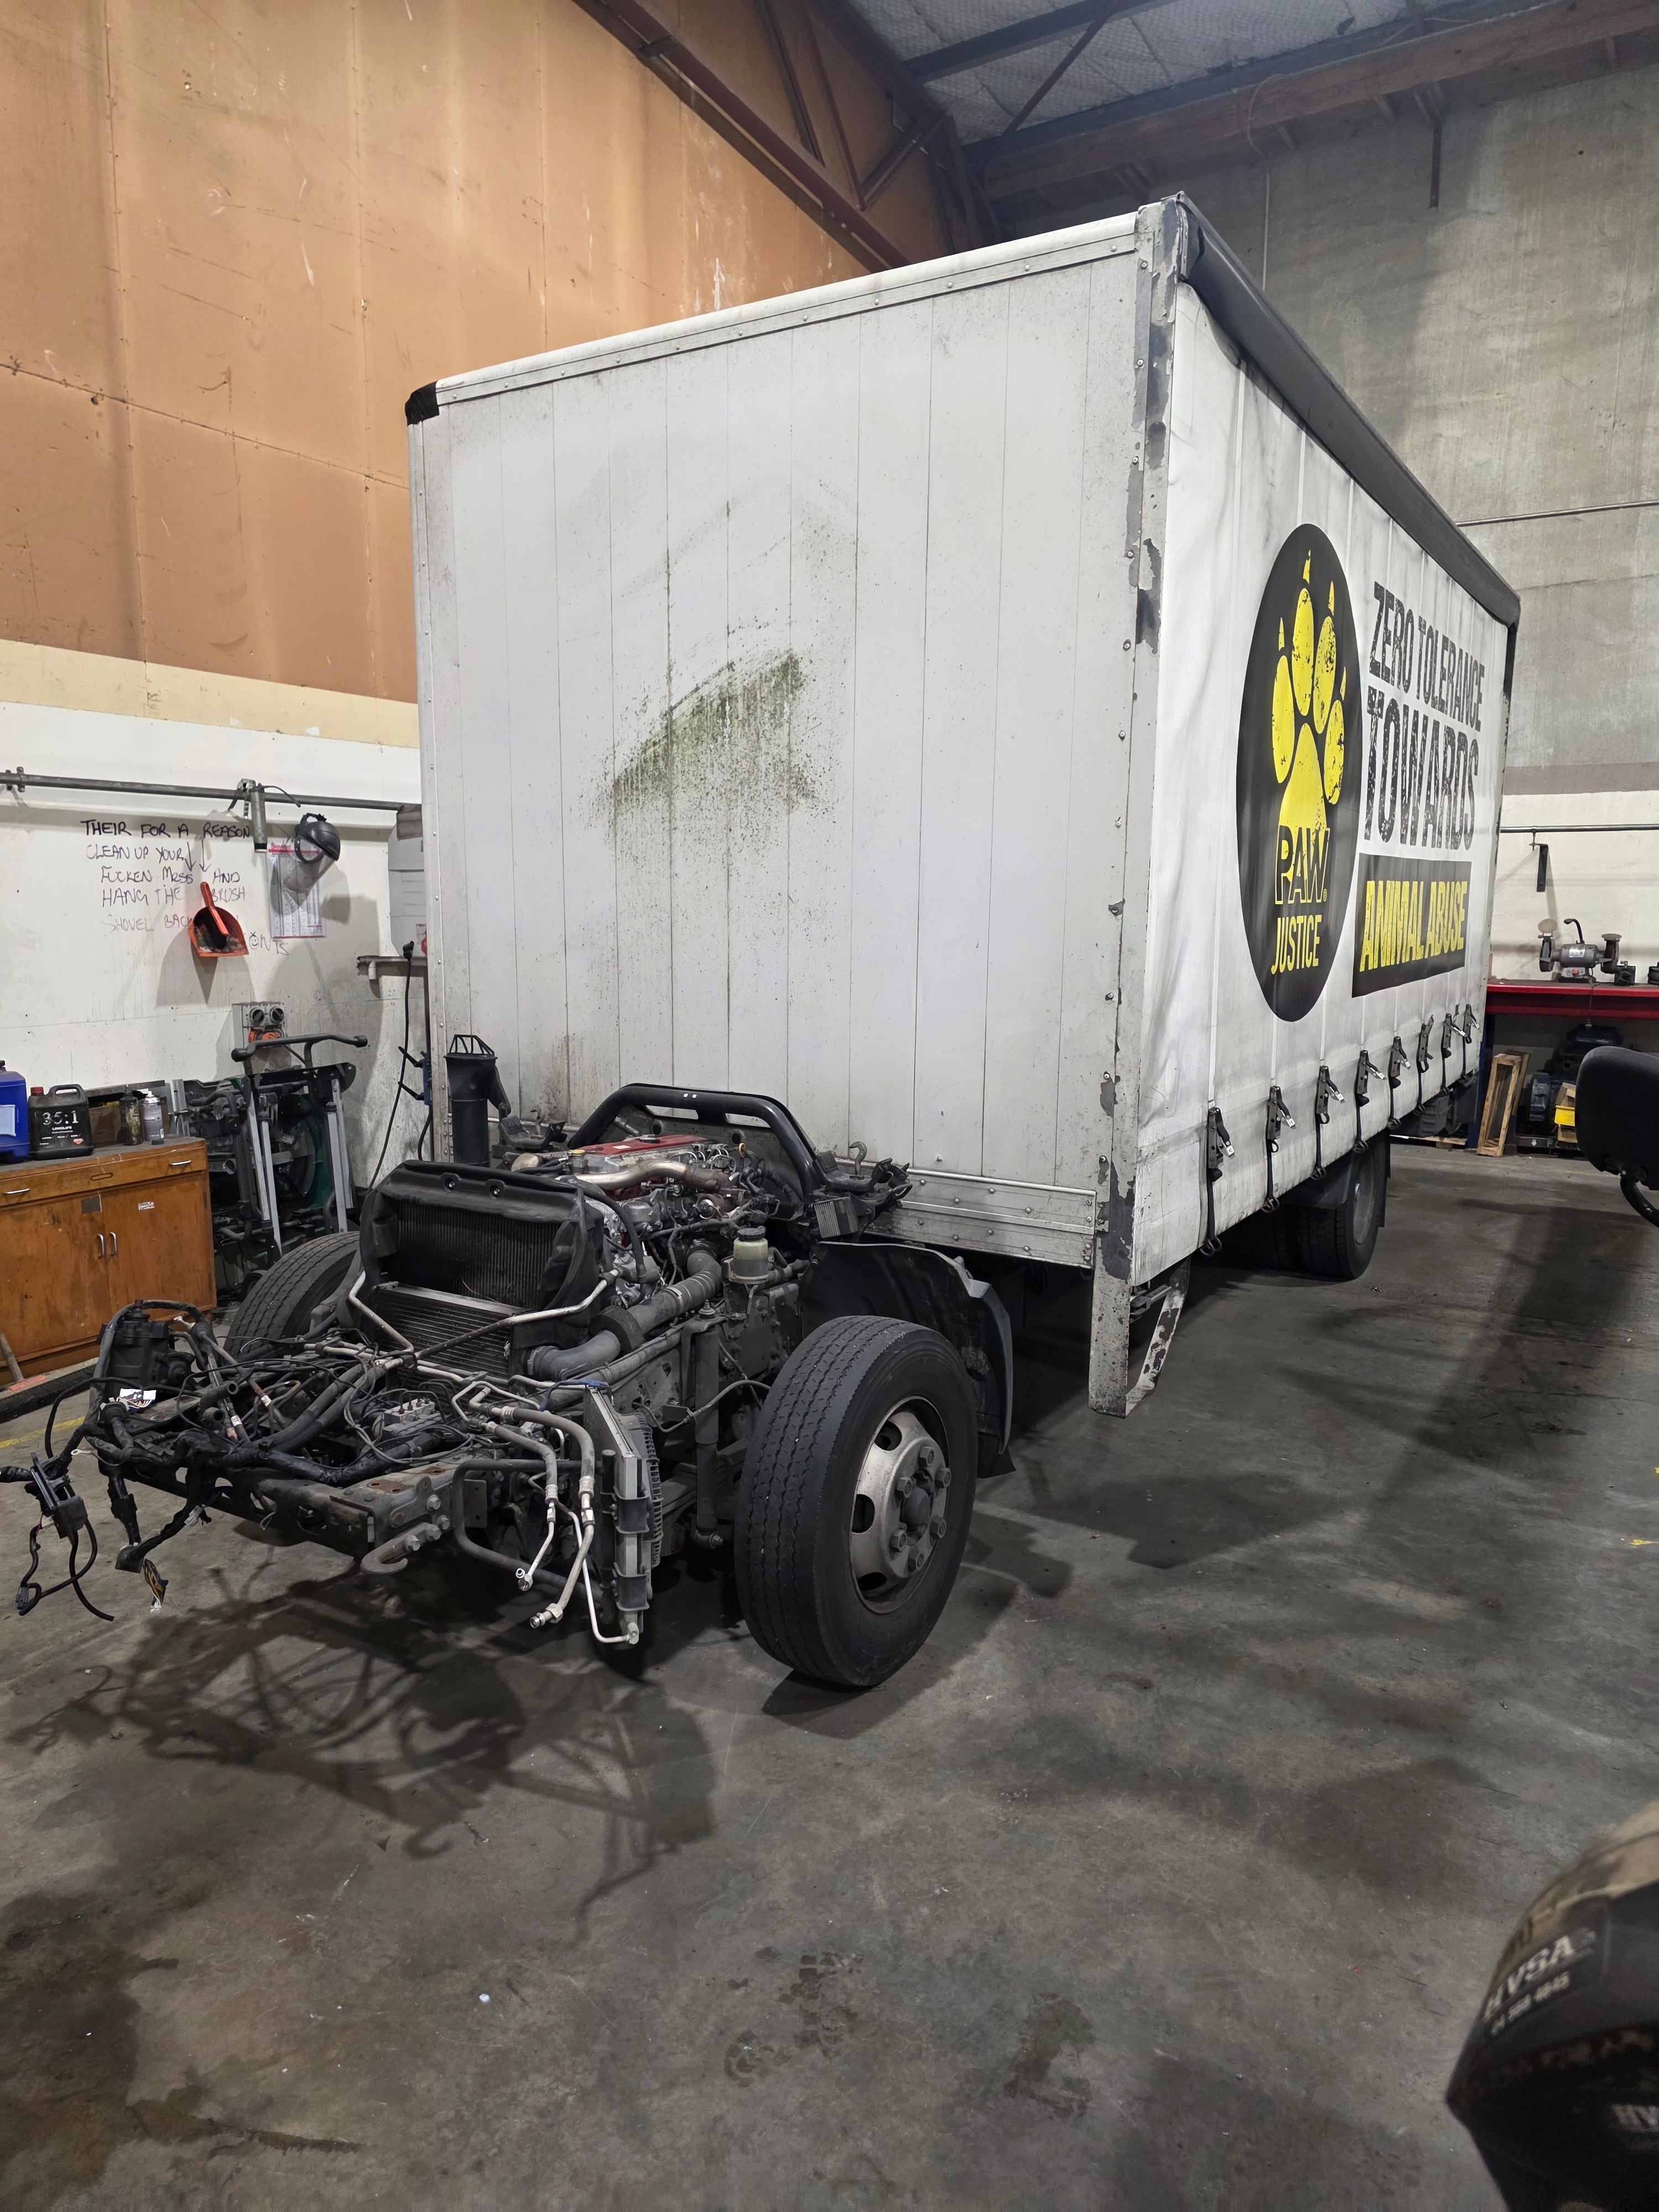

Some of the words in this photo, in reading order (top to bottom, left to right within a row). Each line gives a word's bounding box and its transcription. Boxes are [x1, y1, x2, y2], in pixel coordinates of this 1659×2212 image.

[1369, 581, 1414, 693] ZERO
[1416, 615, 1485, 732] TOLERANCE
[1364, 685, 1479, 851] TOWARDS
[81, 819, 132, 836] THEIR
[141, 823, 171, 838] FOR
[178, 823, 189, 838] A
[203, 821, 250, 838] REASON
[86, 844, 130, 859] CLEAN
[134, 847, 149, 859] UP
[155, 847, 184, 863] YOUR
[212, 868, 240, 884] AND
[102, 888, 148, 907] HANG
[155, 887, 185, 905] THE
[102, 914, 154, 937] SHOVEL
[1360, 880, 1424, 972] ANIMAL
[1425, 881, 1468, 958] ABUSE
[1271, 915, 1322, 975] JUSTICE
[43, 1110, 79, 1125] 35:1
